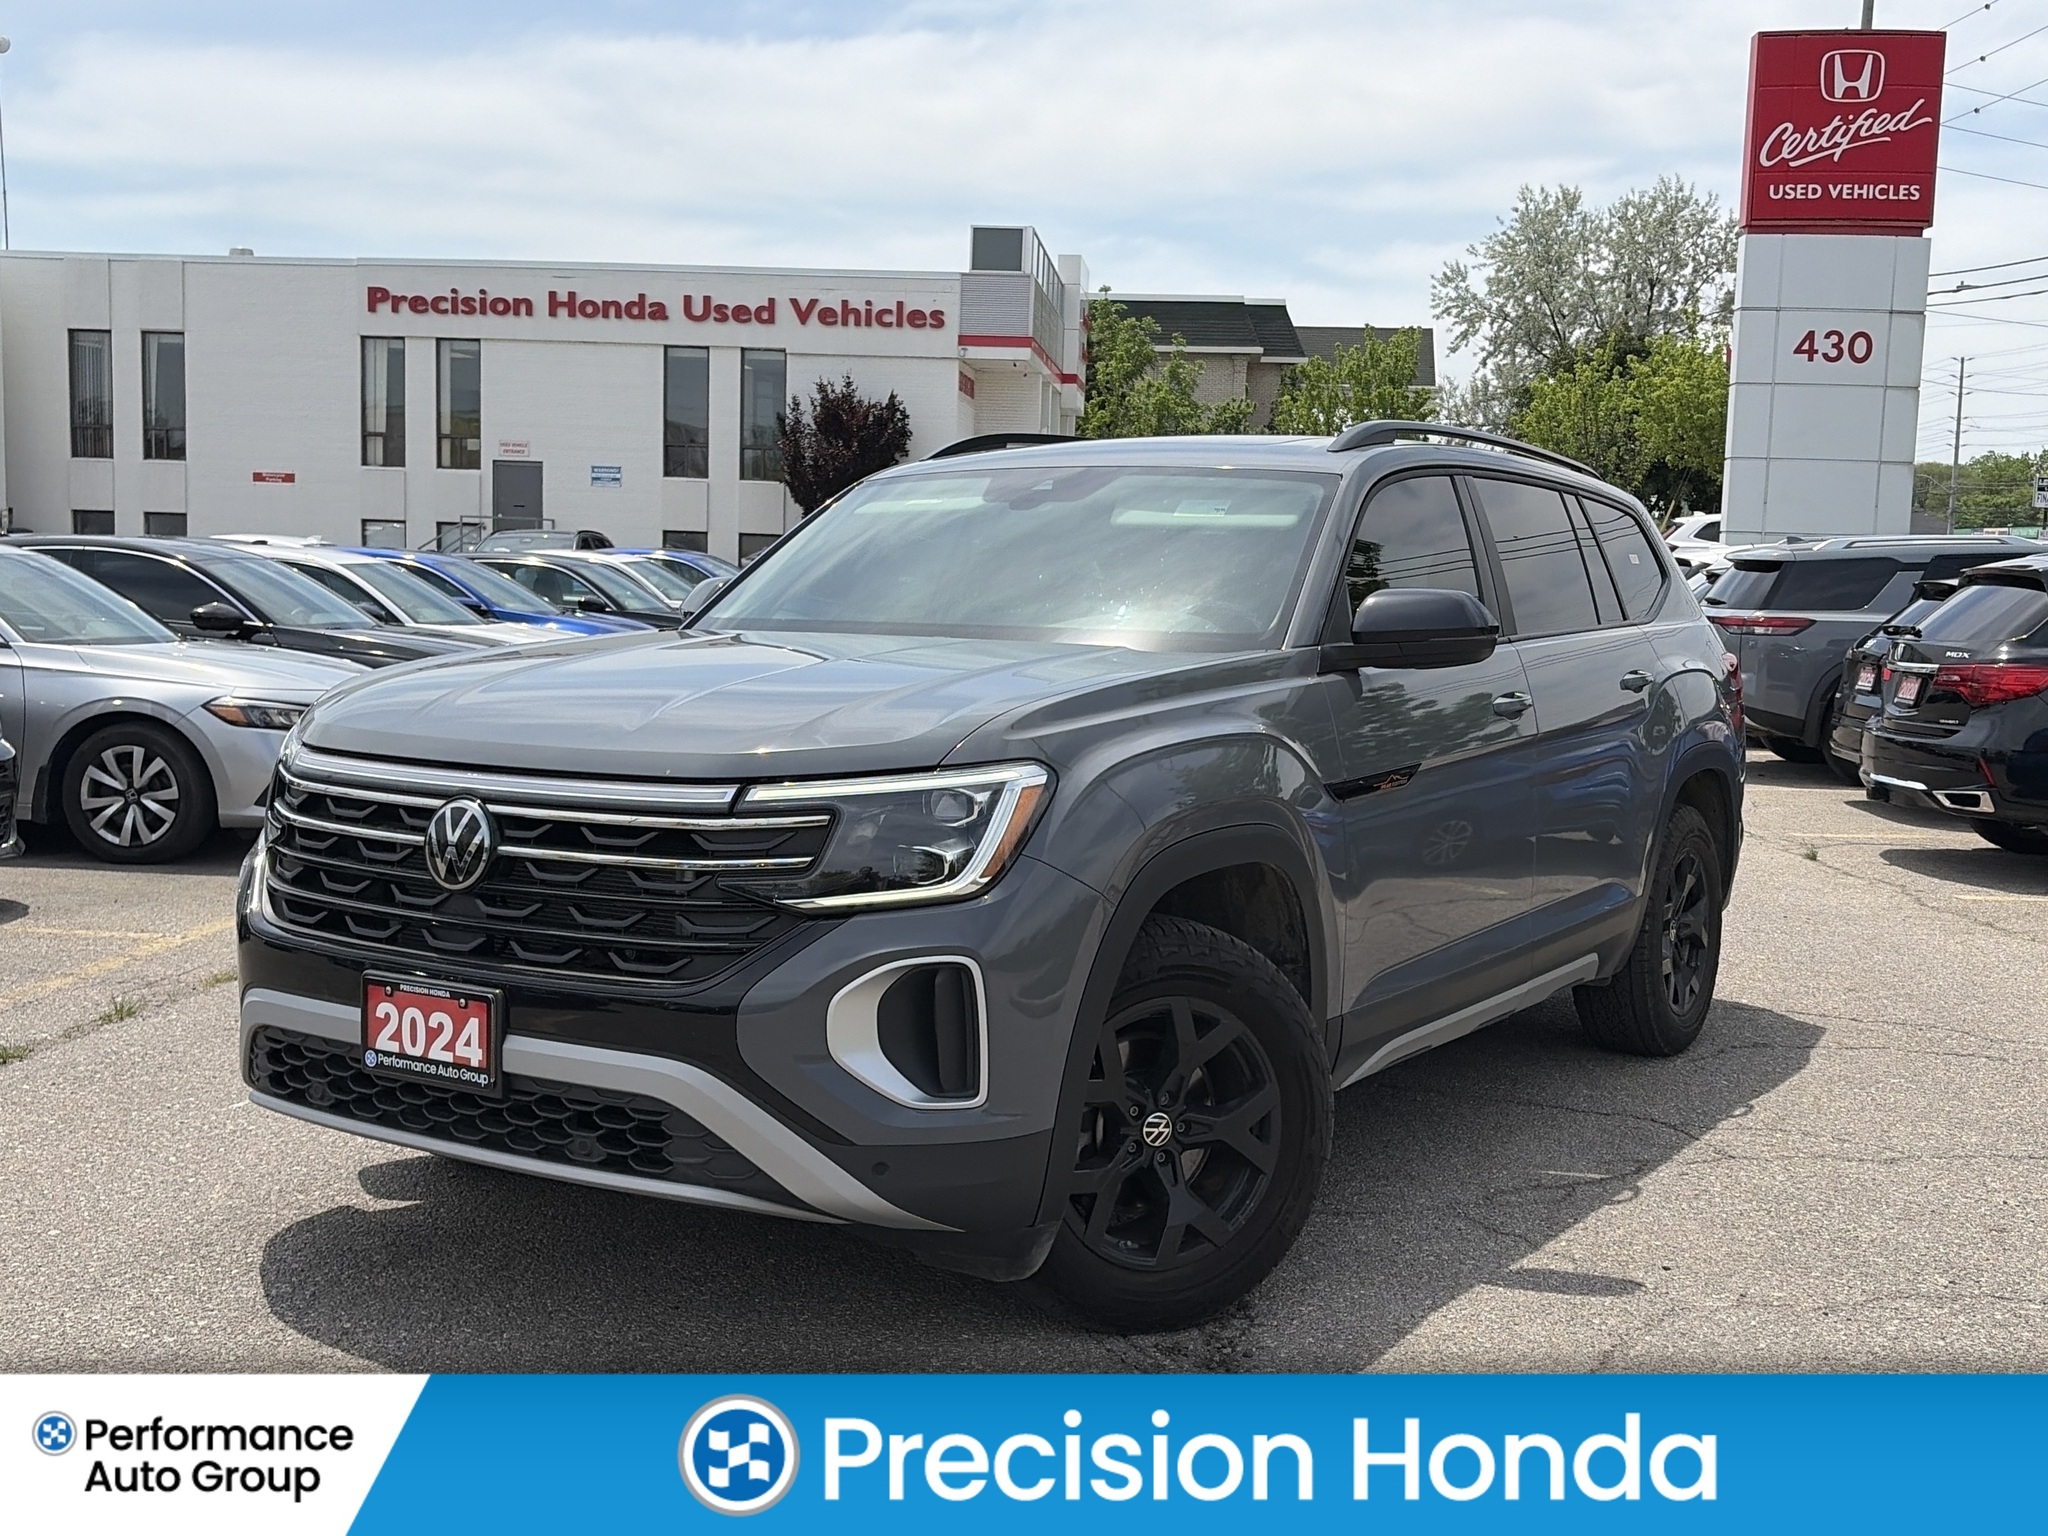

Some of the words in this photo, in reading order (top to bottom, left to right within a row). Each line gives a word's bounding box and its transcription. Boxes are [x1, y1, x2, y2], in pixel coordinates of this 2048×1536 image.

[1759, 99, 1933, 167] Certified
[1769, 184, 1822, 200] USED
[1828, 184, 1920, 200] VEHICLES
[367, 286, 533, 317] Precision
[548, 291, 669, 321] Honda
[683, 295, 776, 324] Used
[789, 298, 946, 328] Vehicles
[1793, 330, 1874, 365] 430
[400, 984, 429, 995] PRECISION
[429, 989, 451, 998] HONDA
[375, 1001, 483, 1067] 2024
[378, 1053, 437, 1075] Performance
[437, 1064, 459, 1079] Auto
[459, 1068, 489, 1087] Group
